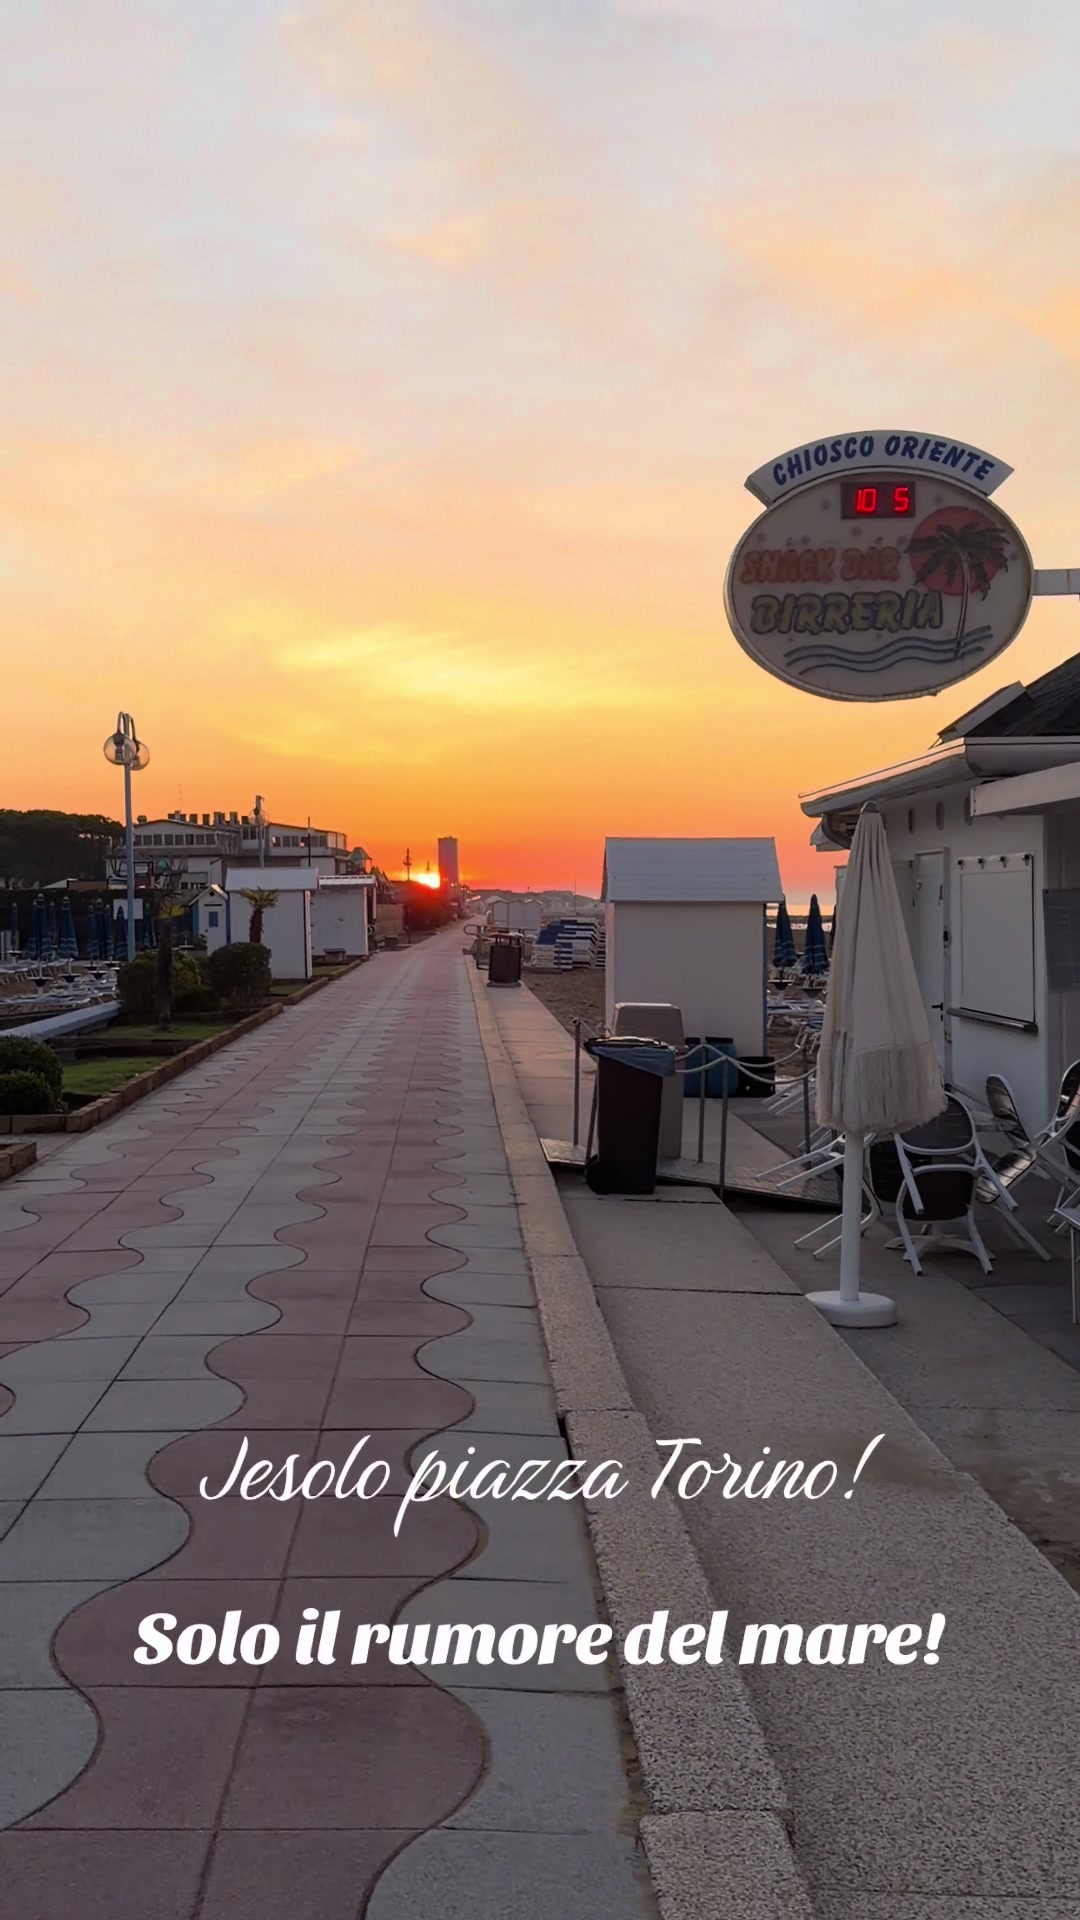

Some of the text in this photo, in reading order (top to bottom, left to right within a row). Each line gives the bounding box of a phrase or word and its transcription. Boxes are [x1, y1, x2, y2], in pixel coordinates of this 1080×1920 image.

[773, 434, 995, 486] CHIOSCO ORIENTE
[740, 547, 901, 585] SNACK BAR
[749, 589, 943, 635] BIRRERIA
